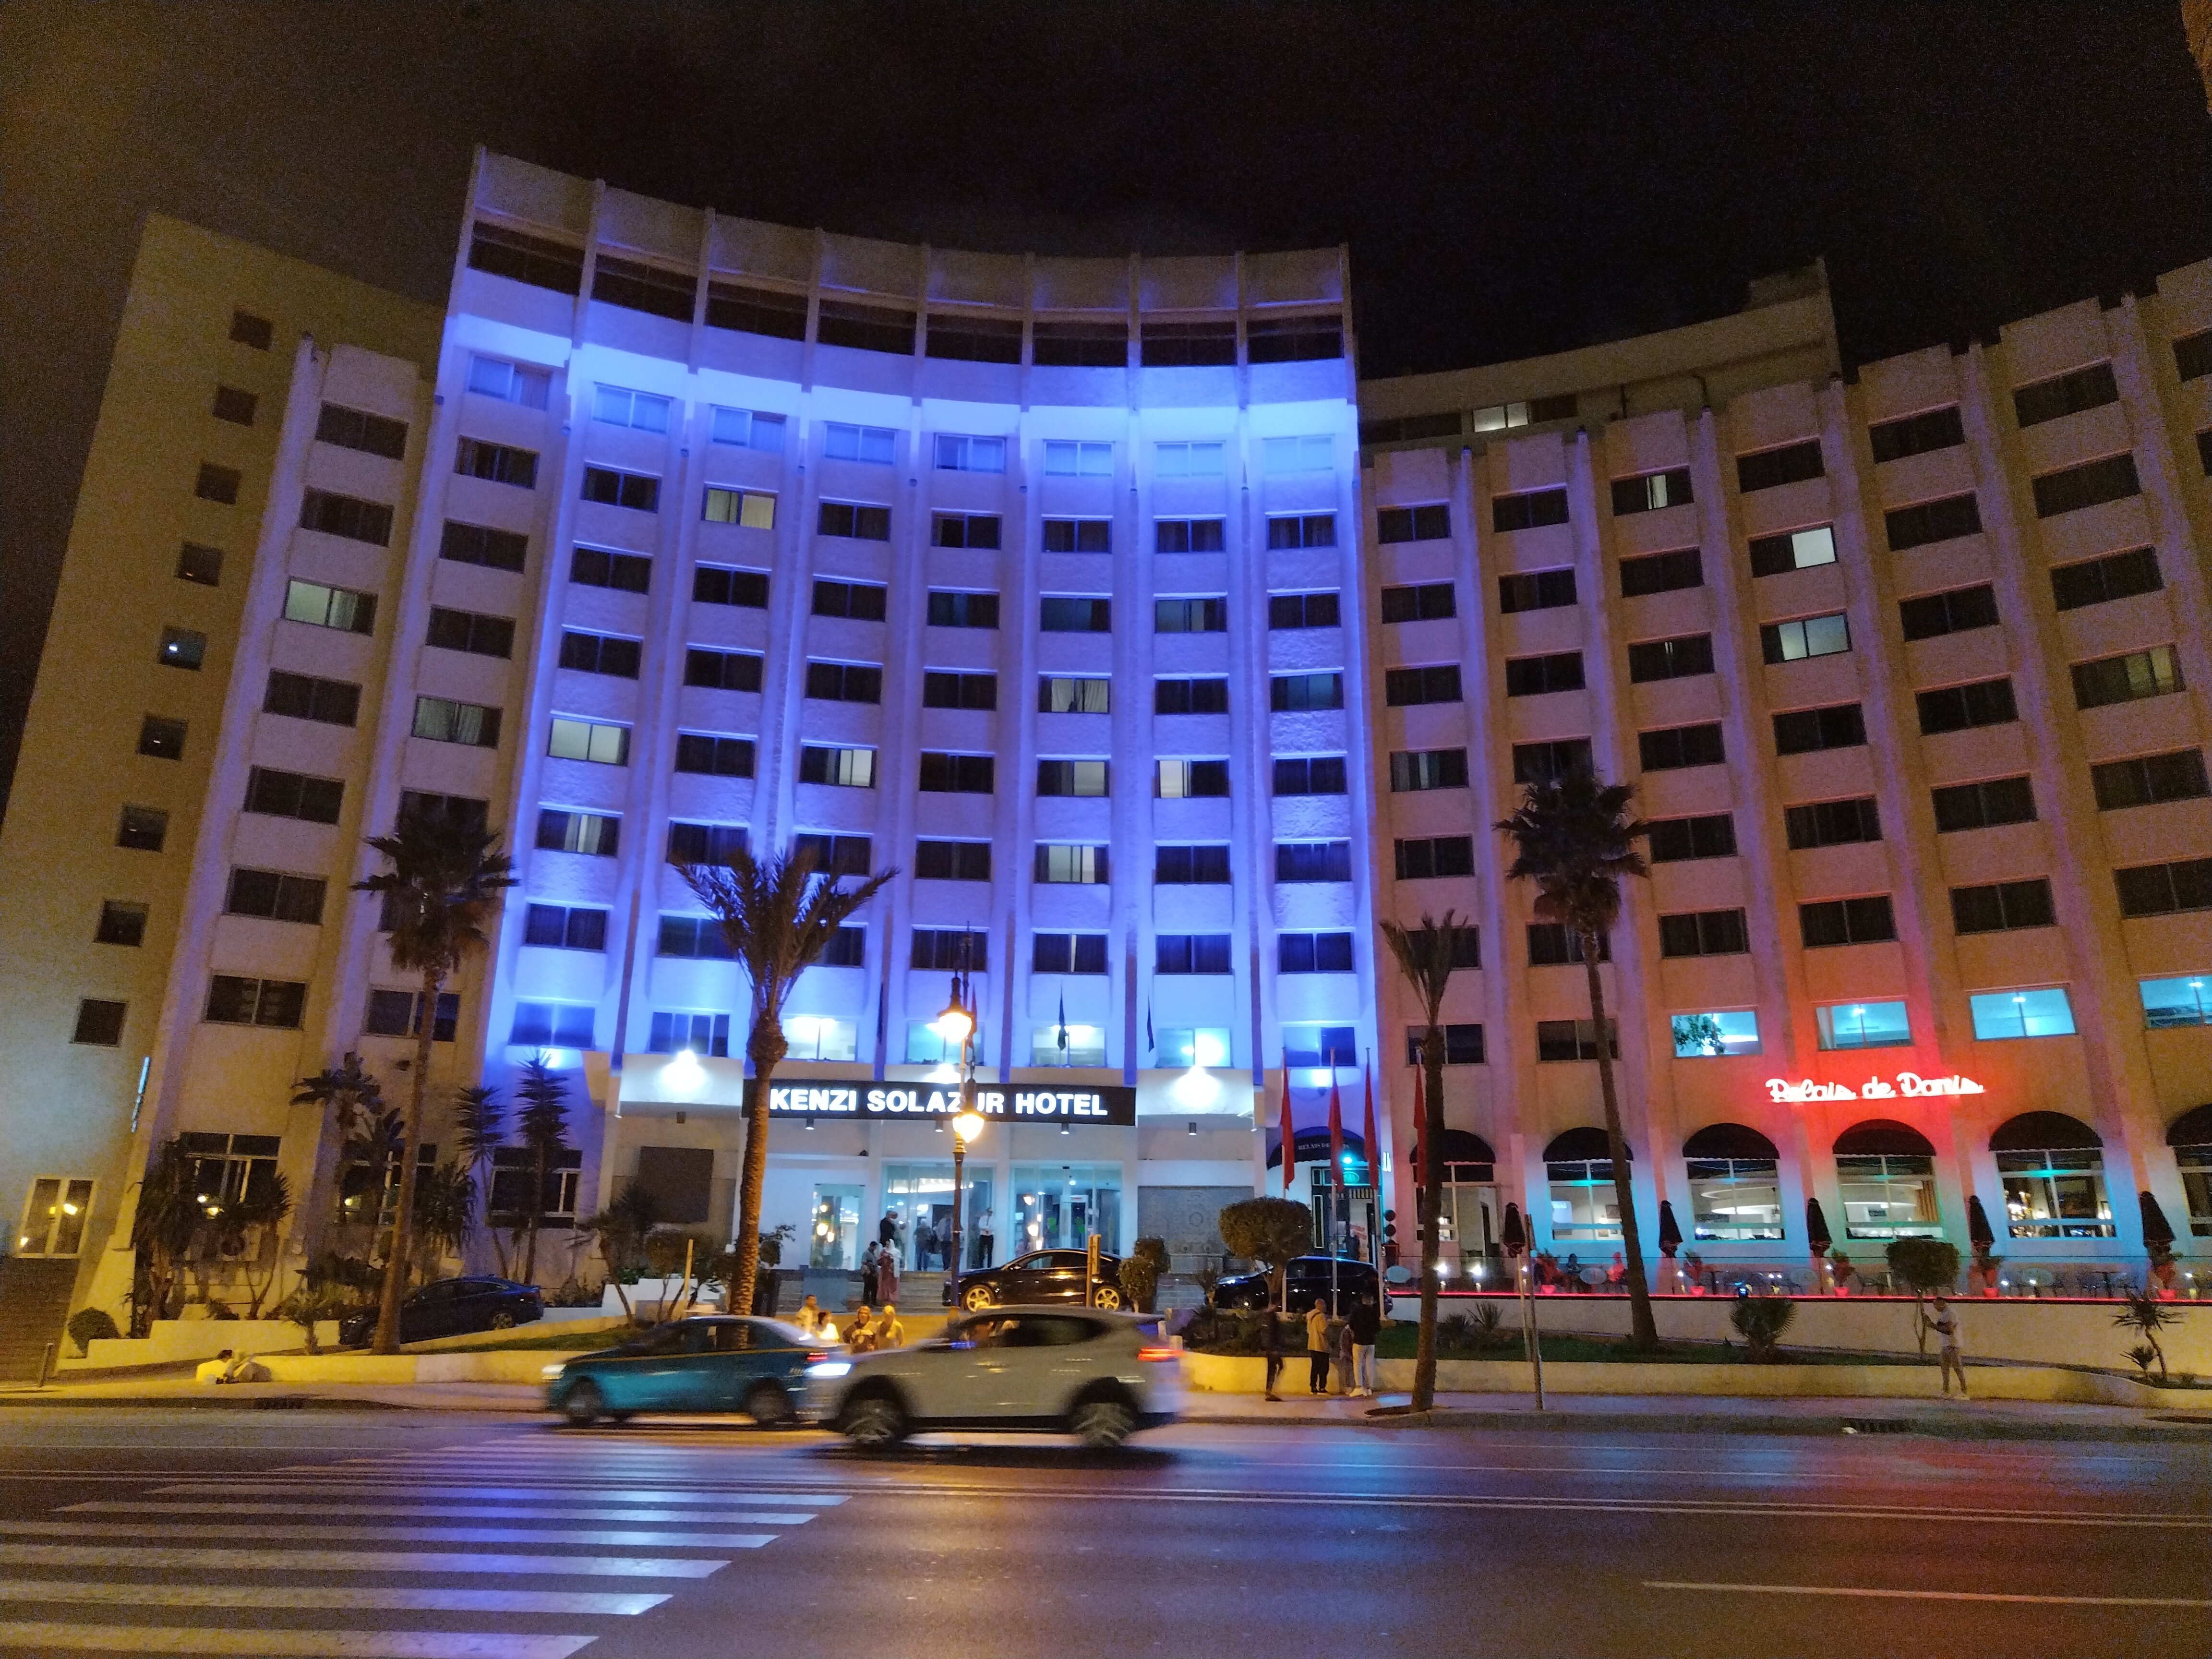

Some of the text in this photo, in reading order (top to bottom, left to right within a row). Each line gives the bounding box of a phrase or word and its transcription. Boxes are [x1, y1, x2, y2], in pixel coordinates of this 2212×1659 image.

[770, 1088, 857, 1111] KENZI
[1015, 1093, 1108, 1116] HOTEL
[1765, 1078, 1858, 1103] Relais
[1862, 1076, 1897, 1099] de
